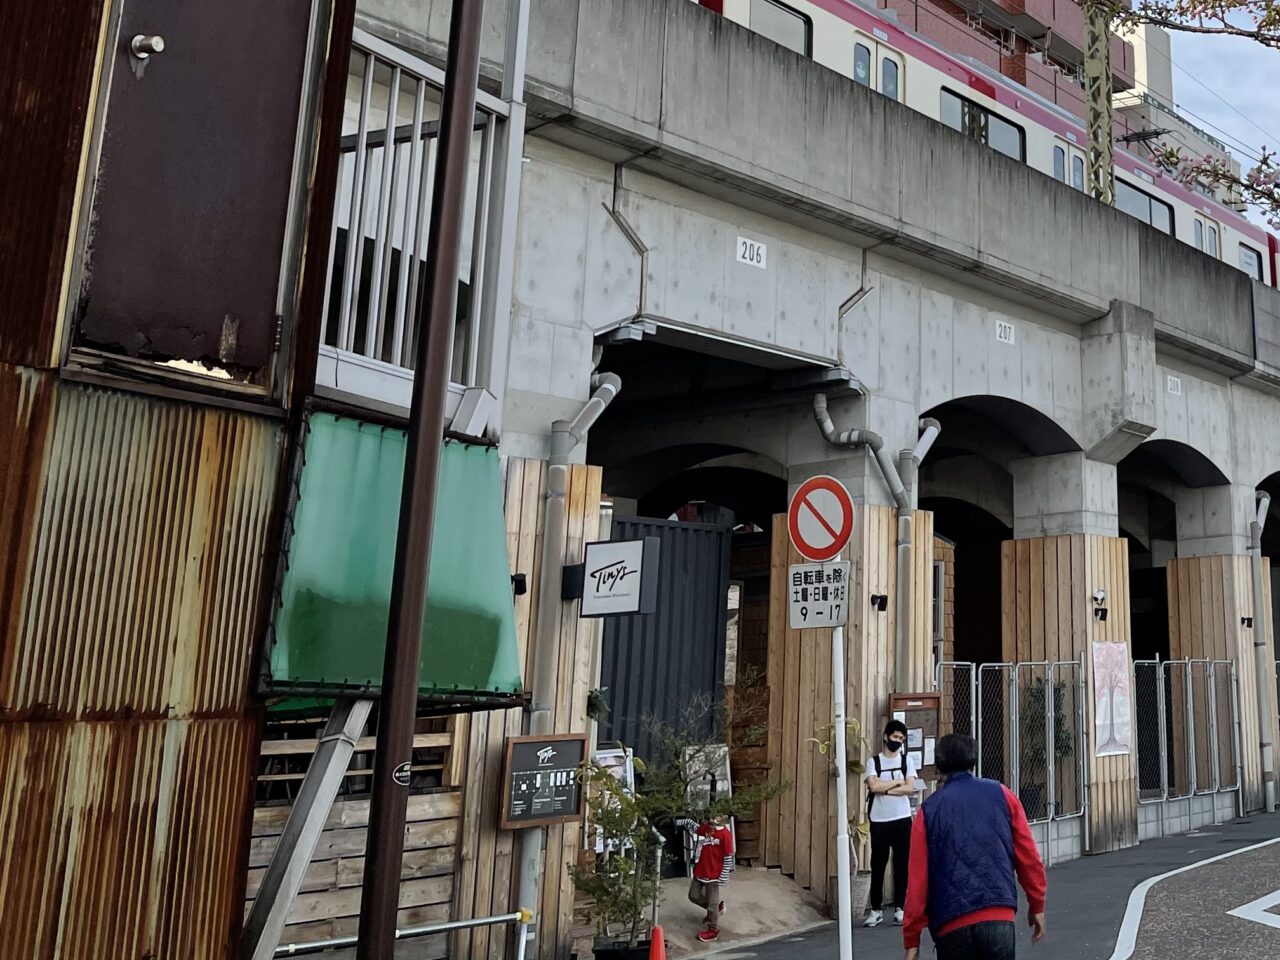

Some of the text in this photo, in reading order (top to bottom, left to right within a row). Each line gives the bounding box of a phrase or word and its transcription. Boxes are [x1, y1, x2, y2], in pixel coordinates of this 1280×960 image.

[741, 240, 762, 264] 206
[998, 323, 1012, 341] 207
[792, 567, 848, 586] 自転車を除く
[793, 585, 845, 603] 土曜・日曜・休日
